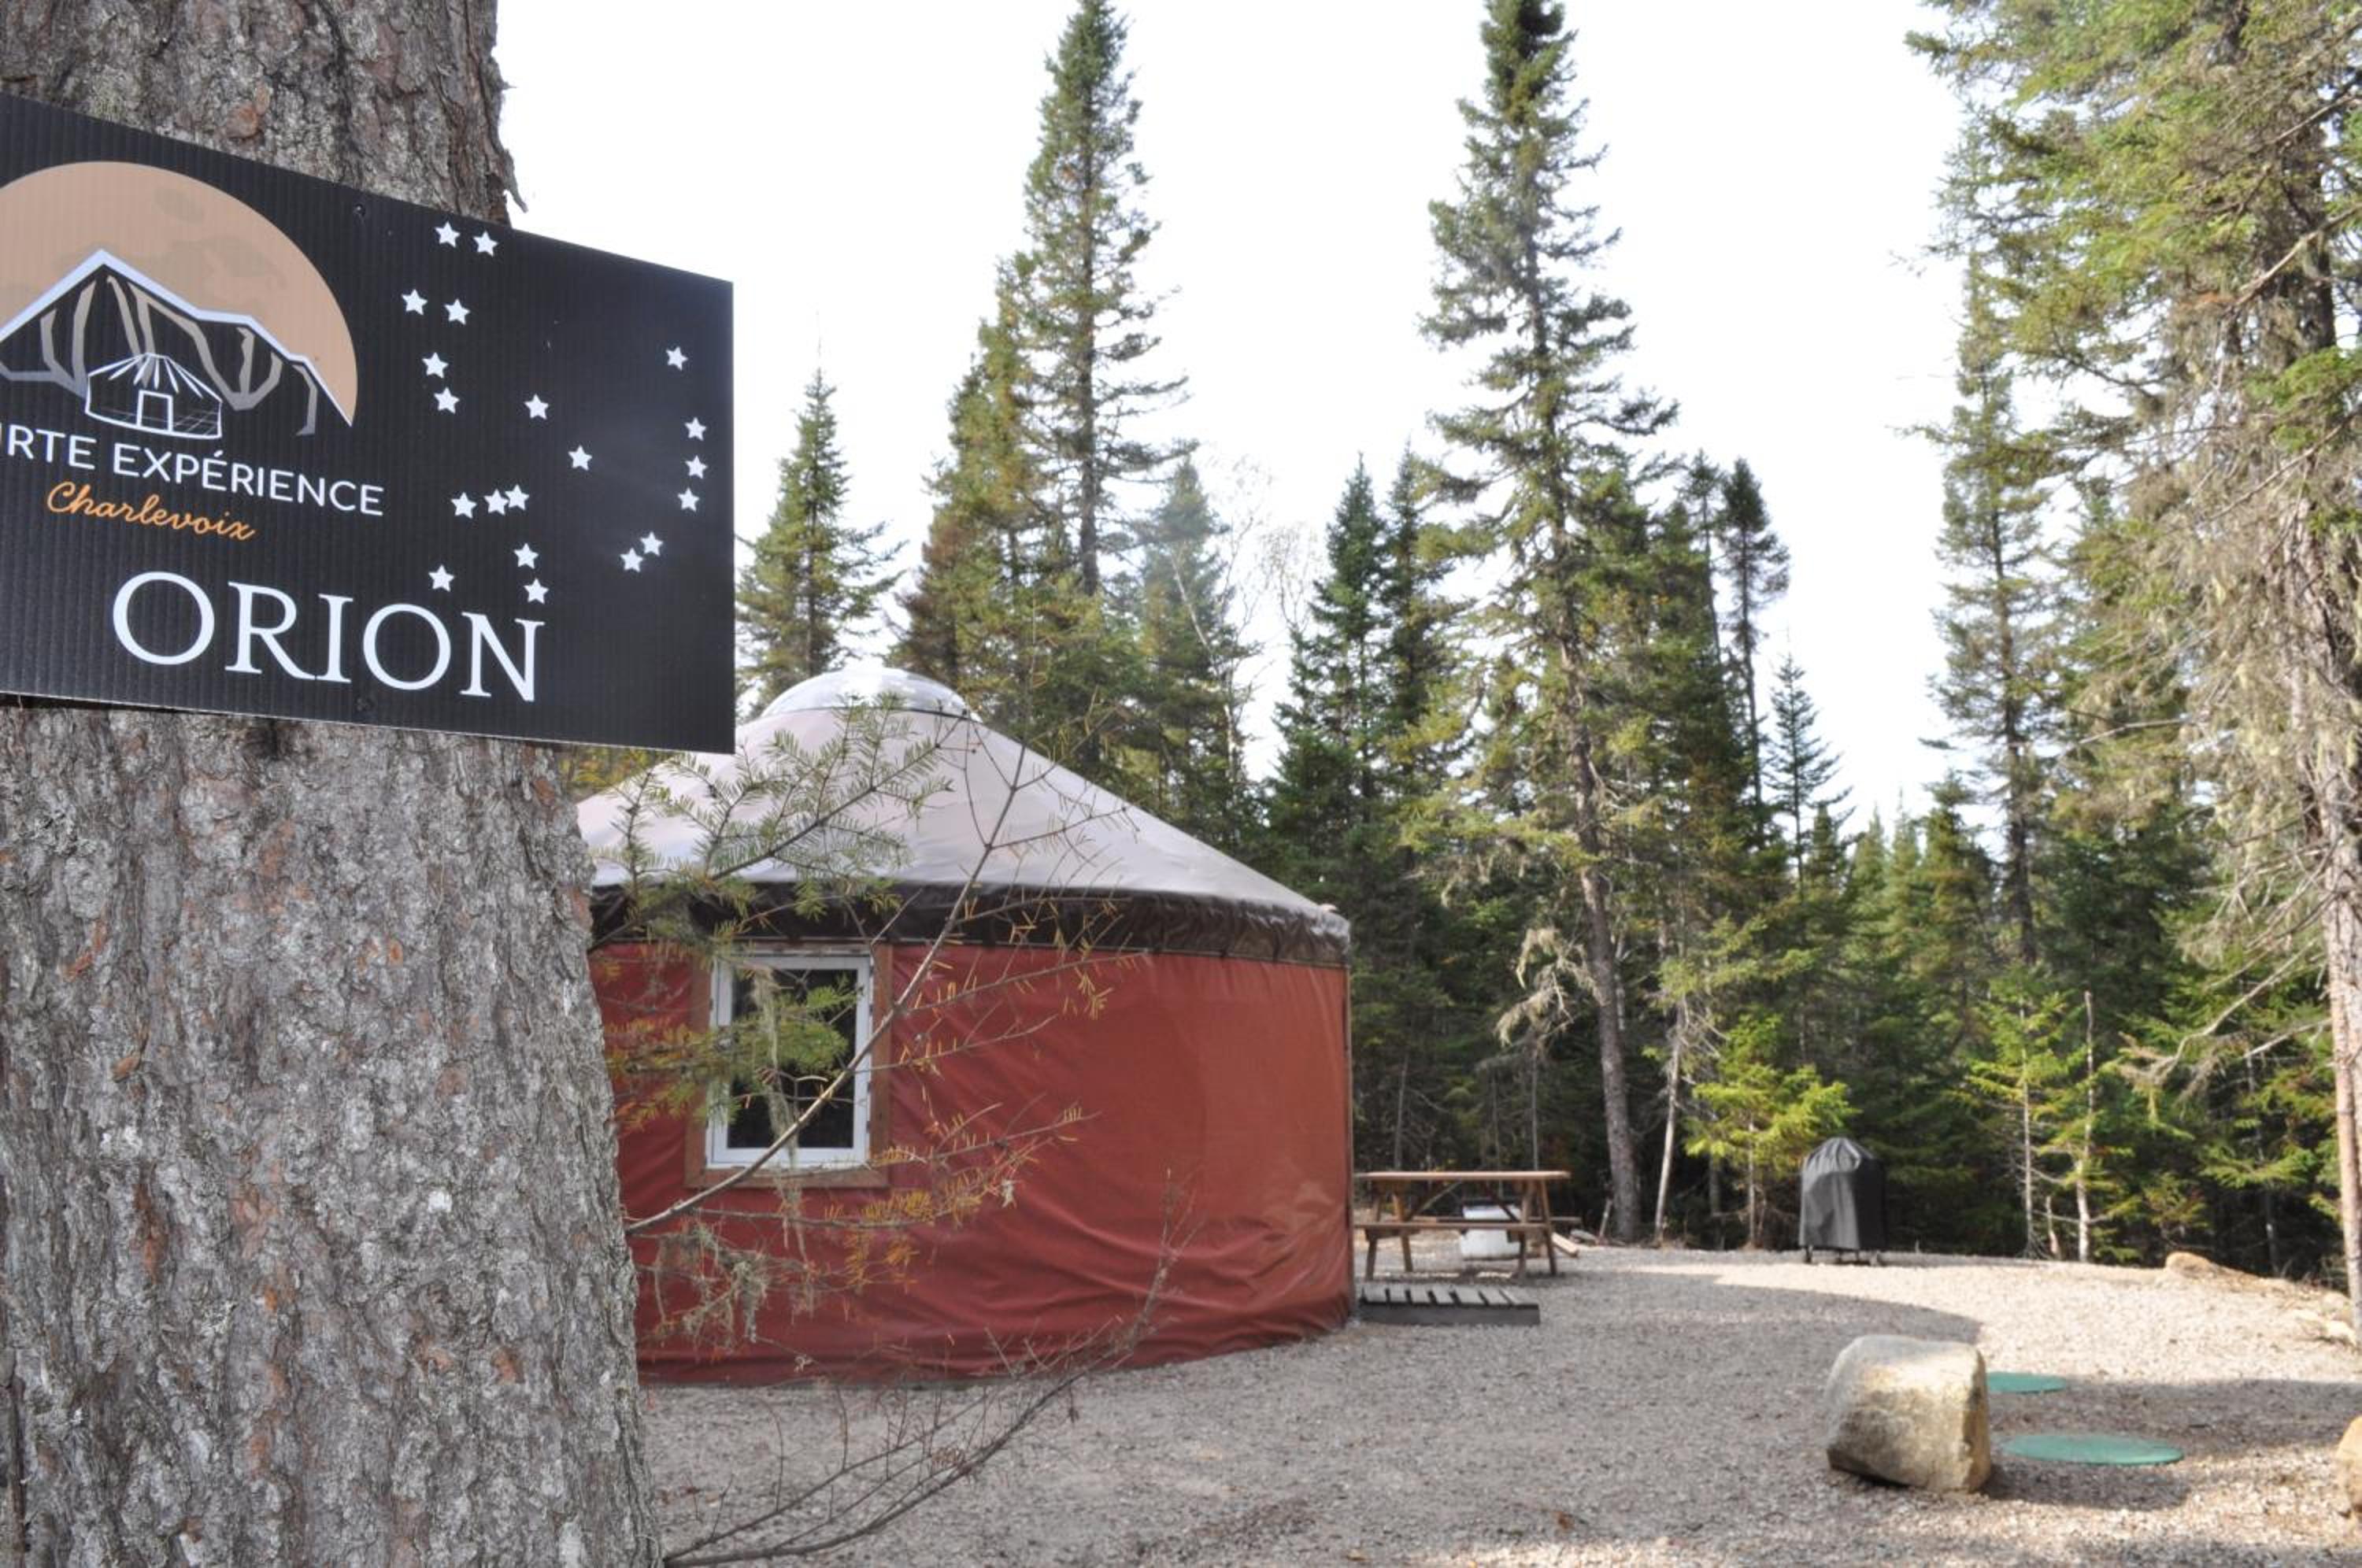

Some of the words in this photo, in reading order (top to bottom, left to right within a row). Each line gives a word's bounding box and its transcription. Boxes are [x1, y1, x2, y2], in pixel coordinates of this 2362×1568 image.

[0, 423, 97, 470] RTE
[113, 442, 384, 516] EXPÉRIENCE
[46, 481, 256, 540] Charlevoix
[113, 571, 546, 702] ORION
